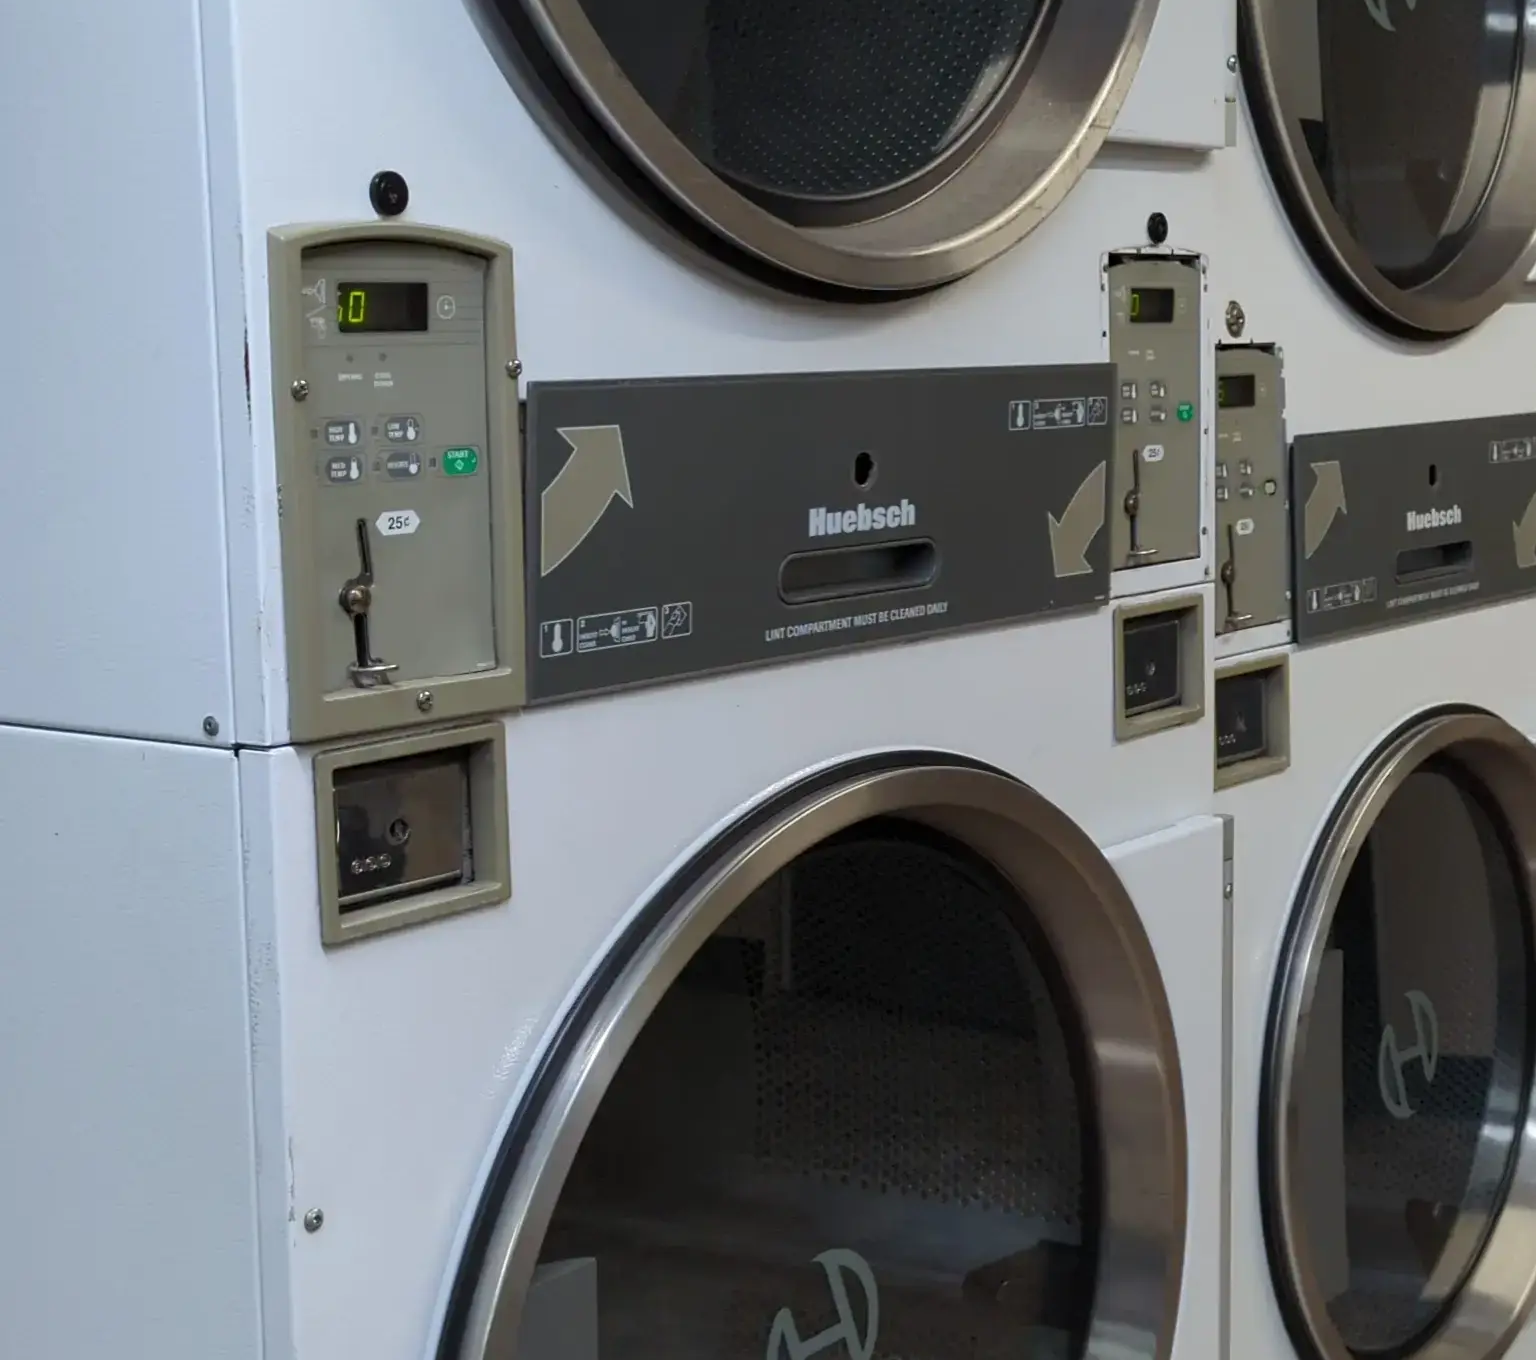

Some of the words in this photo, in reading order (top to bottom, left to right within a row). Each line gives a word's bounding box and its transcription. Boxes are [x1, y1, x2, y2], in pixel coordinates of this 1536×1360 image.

[447, 450, 468, 459] START
[387, 515, 411, 531] 25¢
[808, 498, 916, 538] Huebsch
[1406, 503, 1462, 532] Huebsch
[765, 627, 786, 642] LINT
[786, 616, 852, 639] COMPARTMENT
[853, 612, 877, 628] MUST
[878, 610, 889, 624] BE
[890, 604, 926, 621] CLEANED
[926, 601, 949, 616] DAILY
